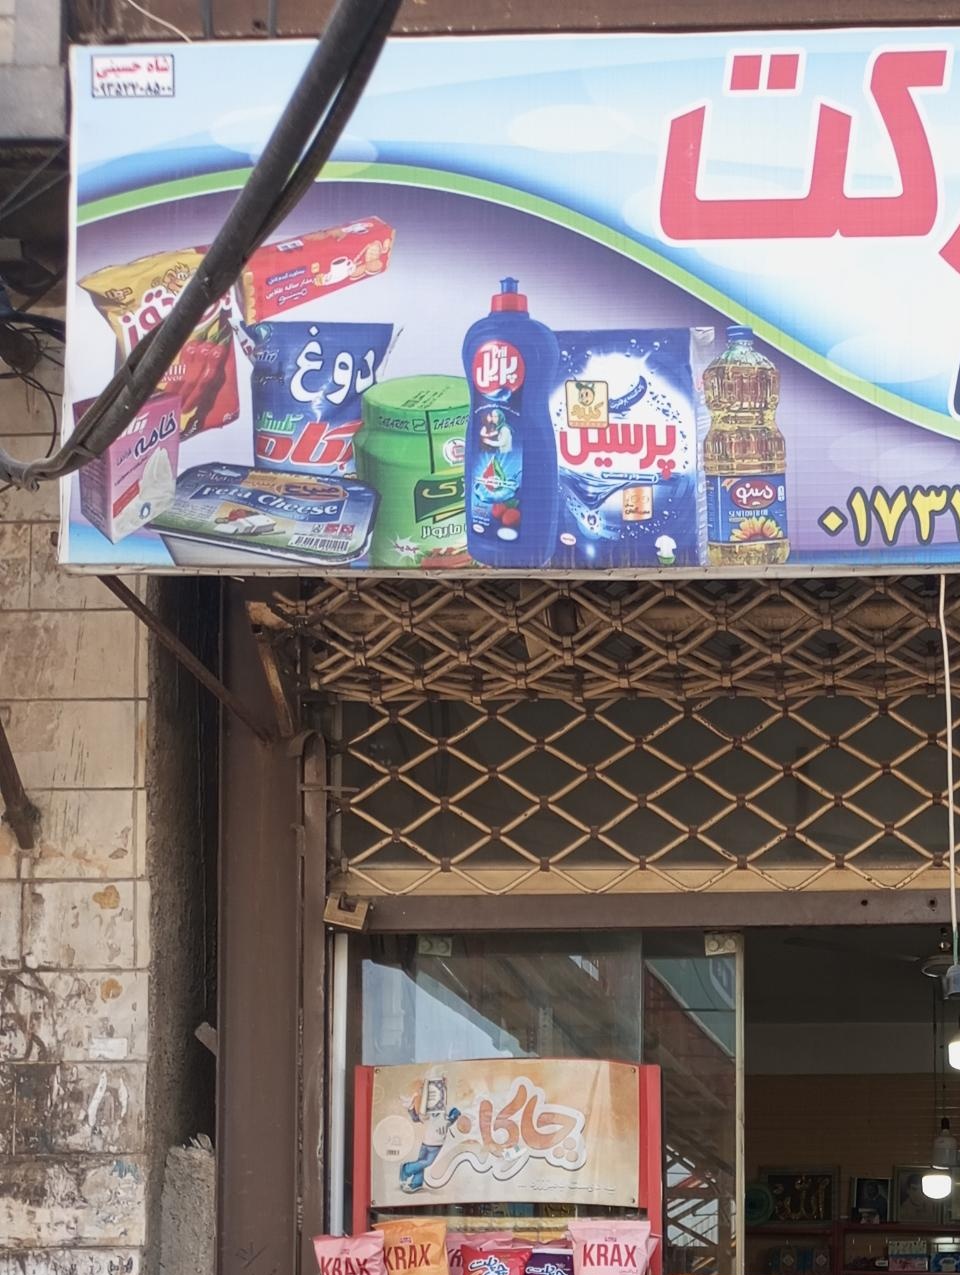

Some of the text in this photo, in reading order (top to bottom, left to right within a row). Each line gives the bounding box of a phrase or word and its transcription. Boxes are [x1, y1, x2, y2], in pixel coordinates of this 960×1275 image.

[290, 325, 376, 405] دوغ
[476, 352, 519, 388] پریل
[257, 495, 338, 516] Cheese
[383, 1243, 431, 1271] KRAX
[581, 1242, 638, 1268] KRAX
